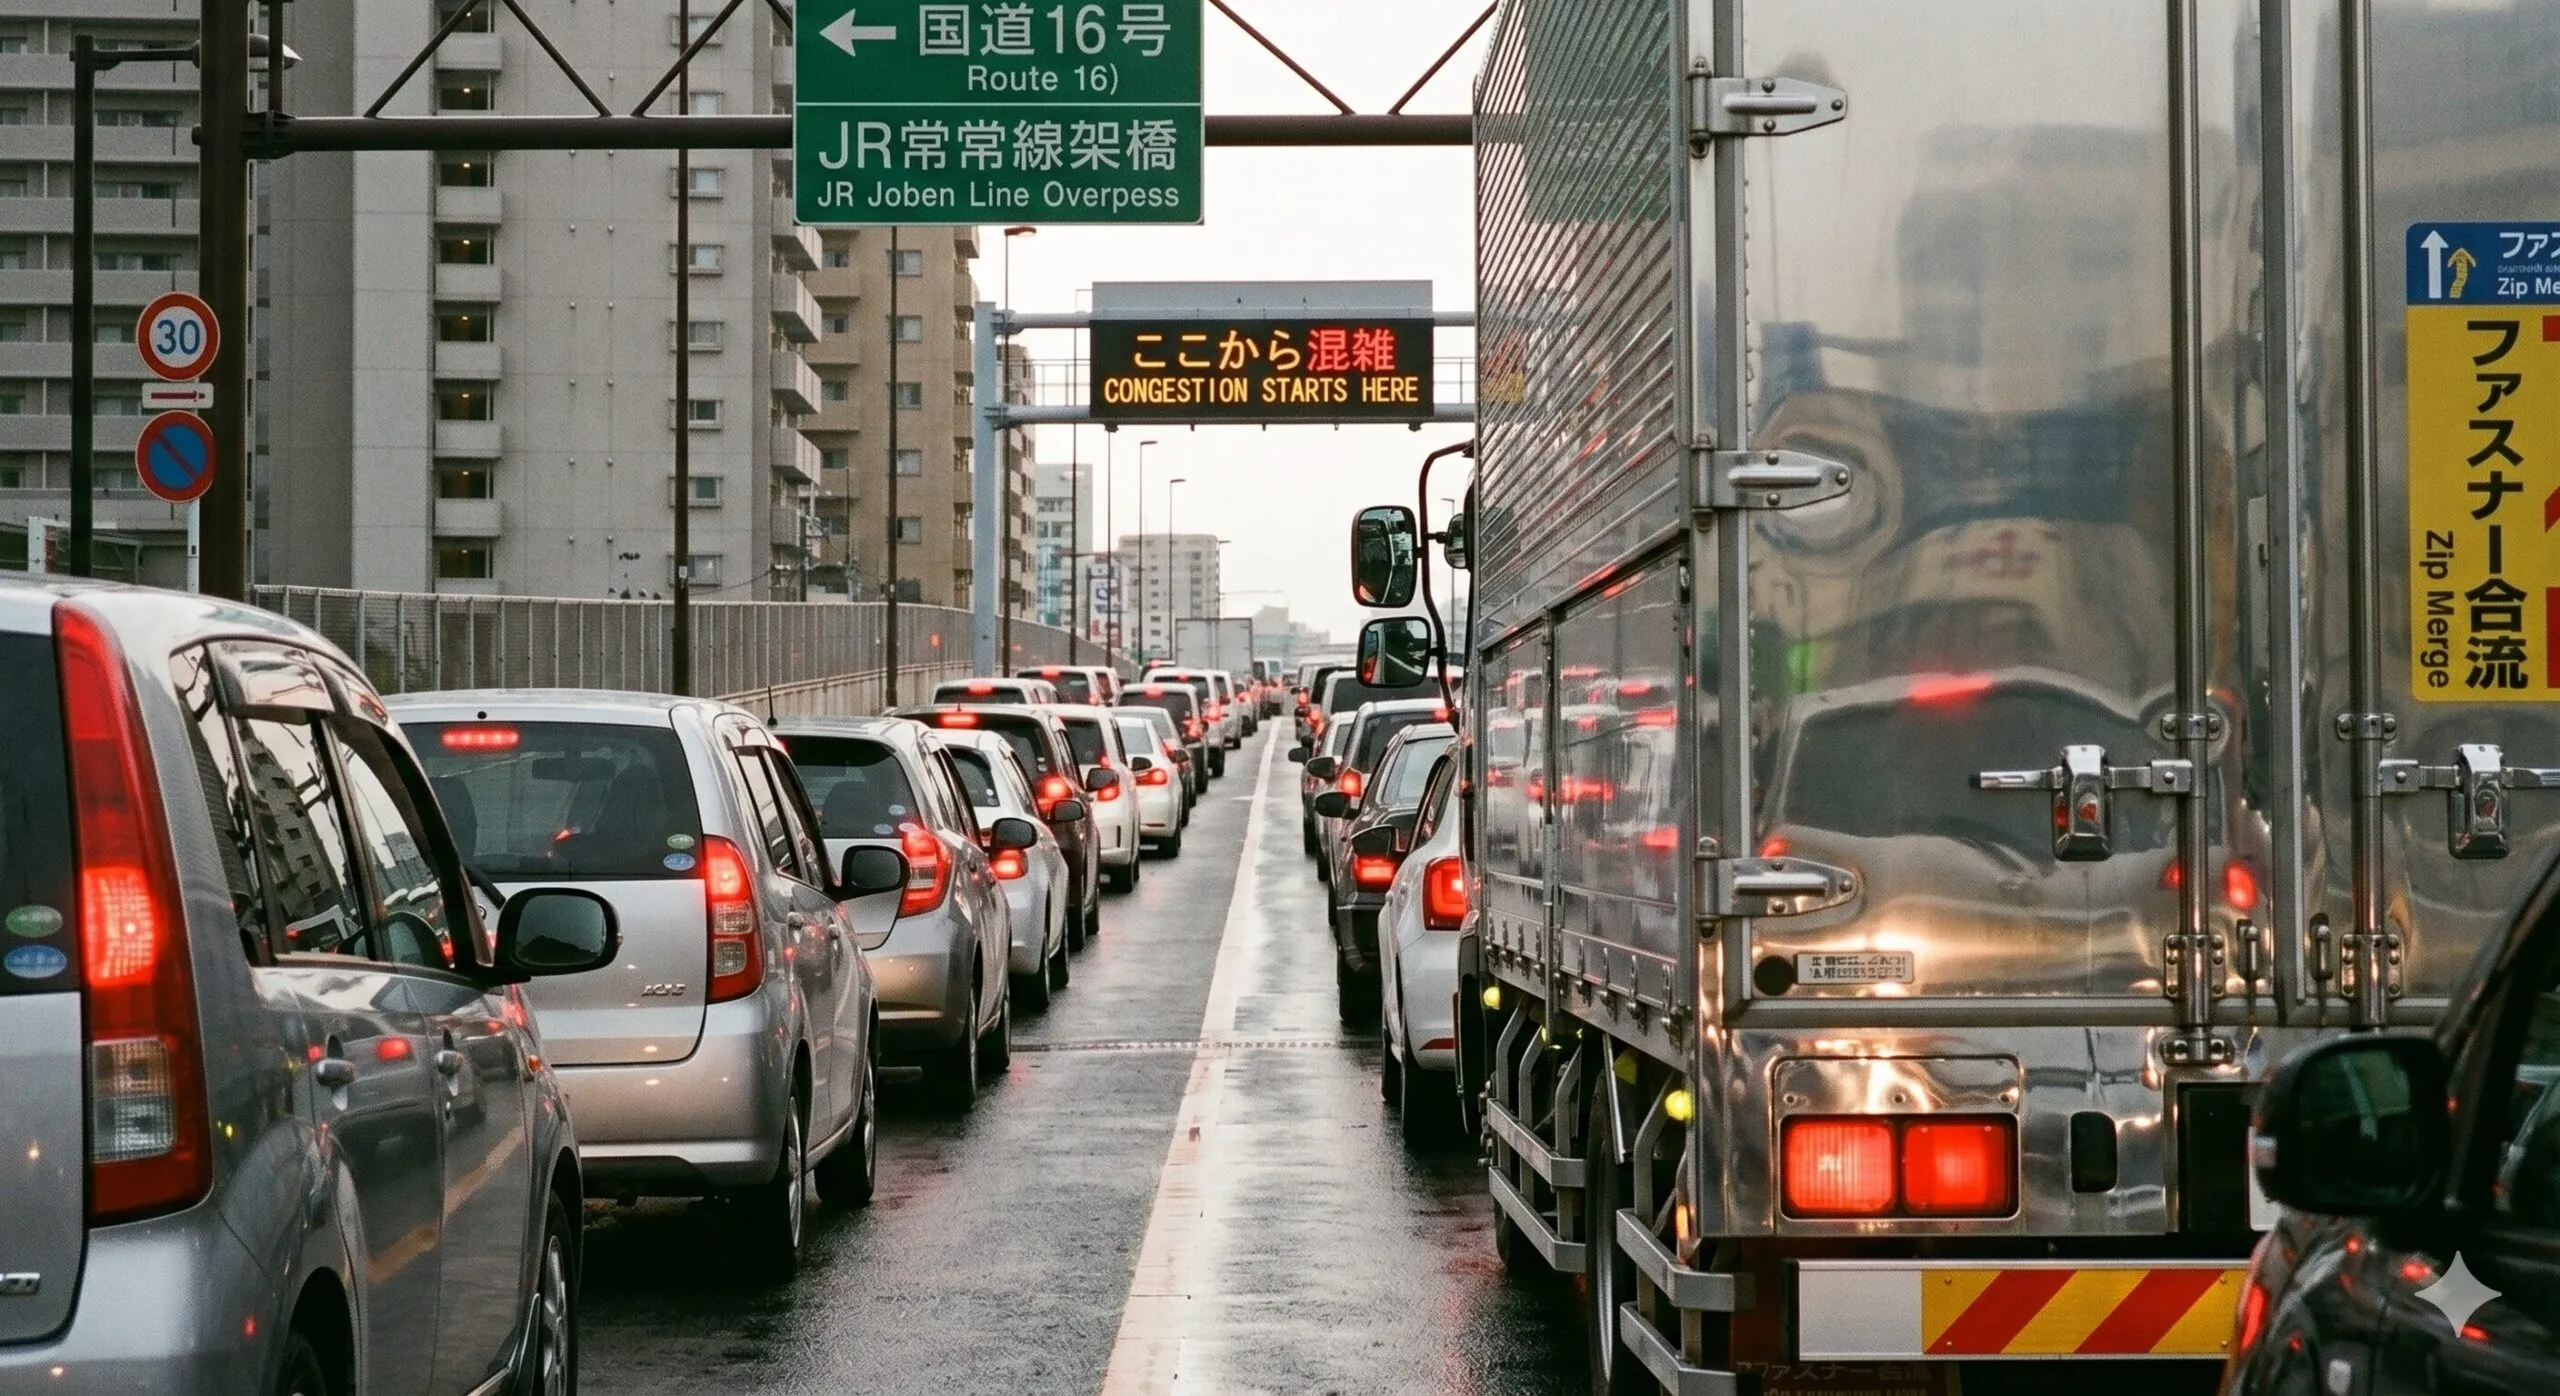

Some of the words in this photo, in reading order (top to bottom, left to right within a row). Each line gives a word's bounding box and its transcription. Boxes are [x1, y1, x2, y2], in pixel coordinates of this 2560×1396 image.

[919, 3, 1171, 57] 国道16号
[967, 65, 1059, 92] Route
[1074, 63, 1119, 95] 16)
[818, 119, 1178, 171] JR常常線架橋
[817, 182, 854, 207] JR
[868, 181, 955, 207] Joben
[970, 182, 1029, 207] Line
[1043, 181, 1180, 213] Overpess
[2497, 277, 2528, 299] Zip
[156, 319, 200, 355] 30
[1134, 329, 1396, 372] ここから混雑
[1104, 377, 1248, 403] CONGESTION
[1262, 377, 1347, 402] STARTS
[1362, 377, 1418, 402] HERE
[2464, 320, 2528, 690] ファスナー合流
[2419, 530, 2454, 580] Zip
[2420, 591, 2455, 689] Merge
